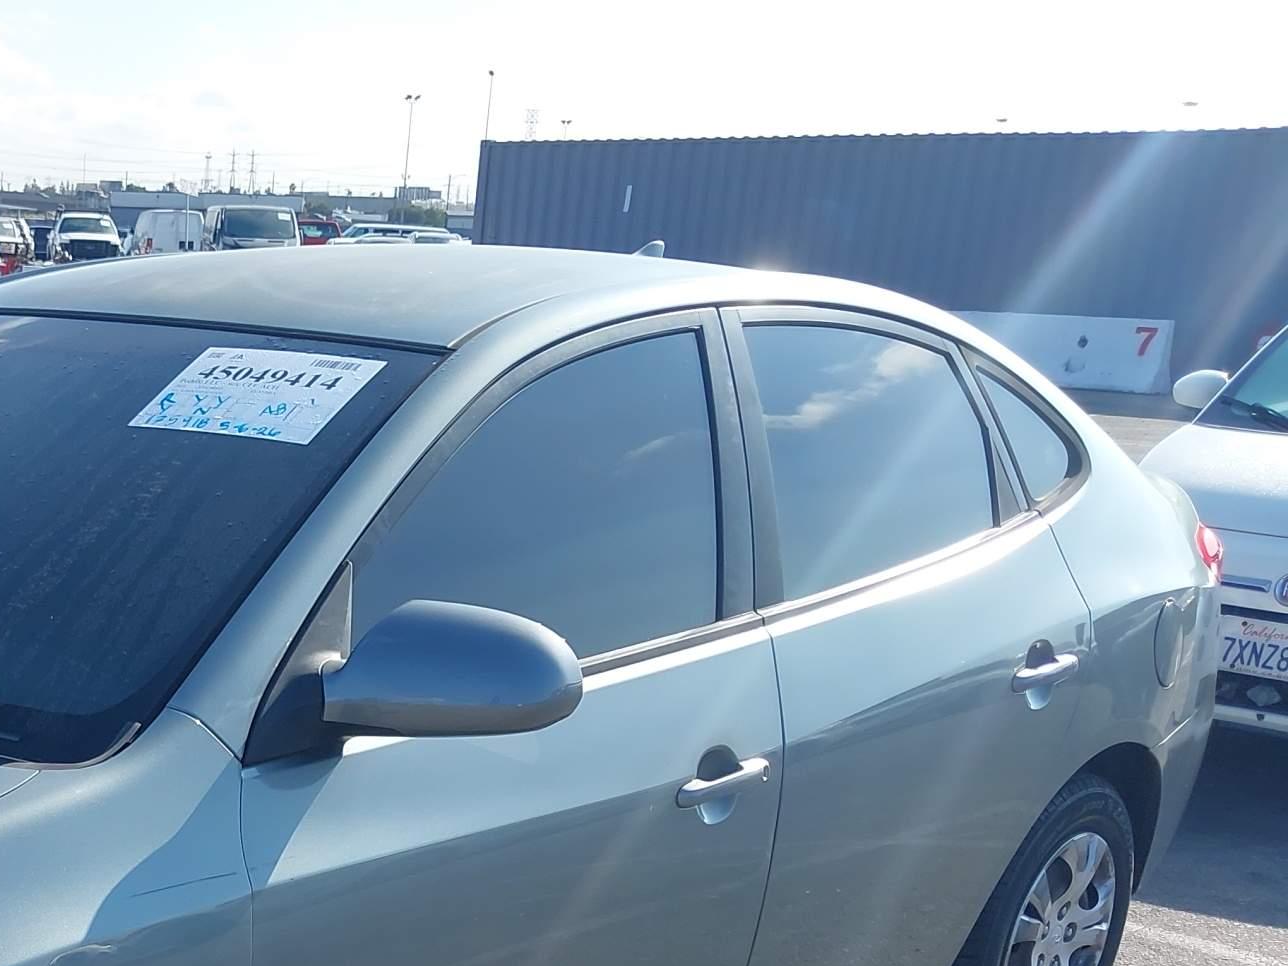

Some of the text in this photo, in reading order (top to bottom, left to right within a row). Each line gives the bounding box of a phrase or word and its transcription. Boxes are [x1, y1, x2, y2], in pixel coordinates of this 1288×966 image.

[1135, 326, 1159, 357] 7
[198, 365, 344, 391] 45049414
[1222, 636, 1288, 672] 7XNZ8
